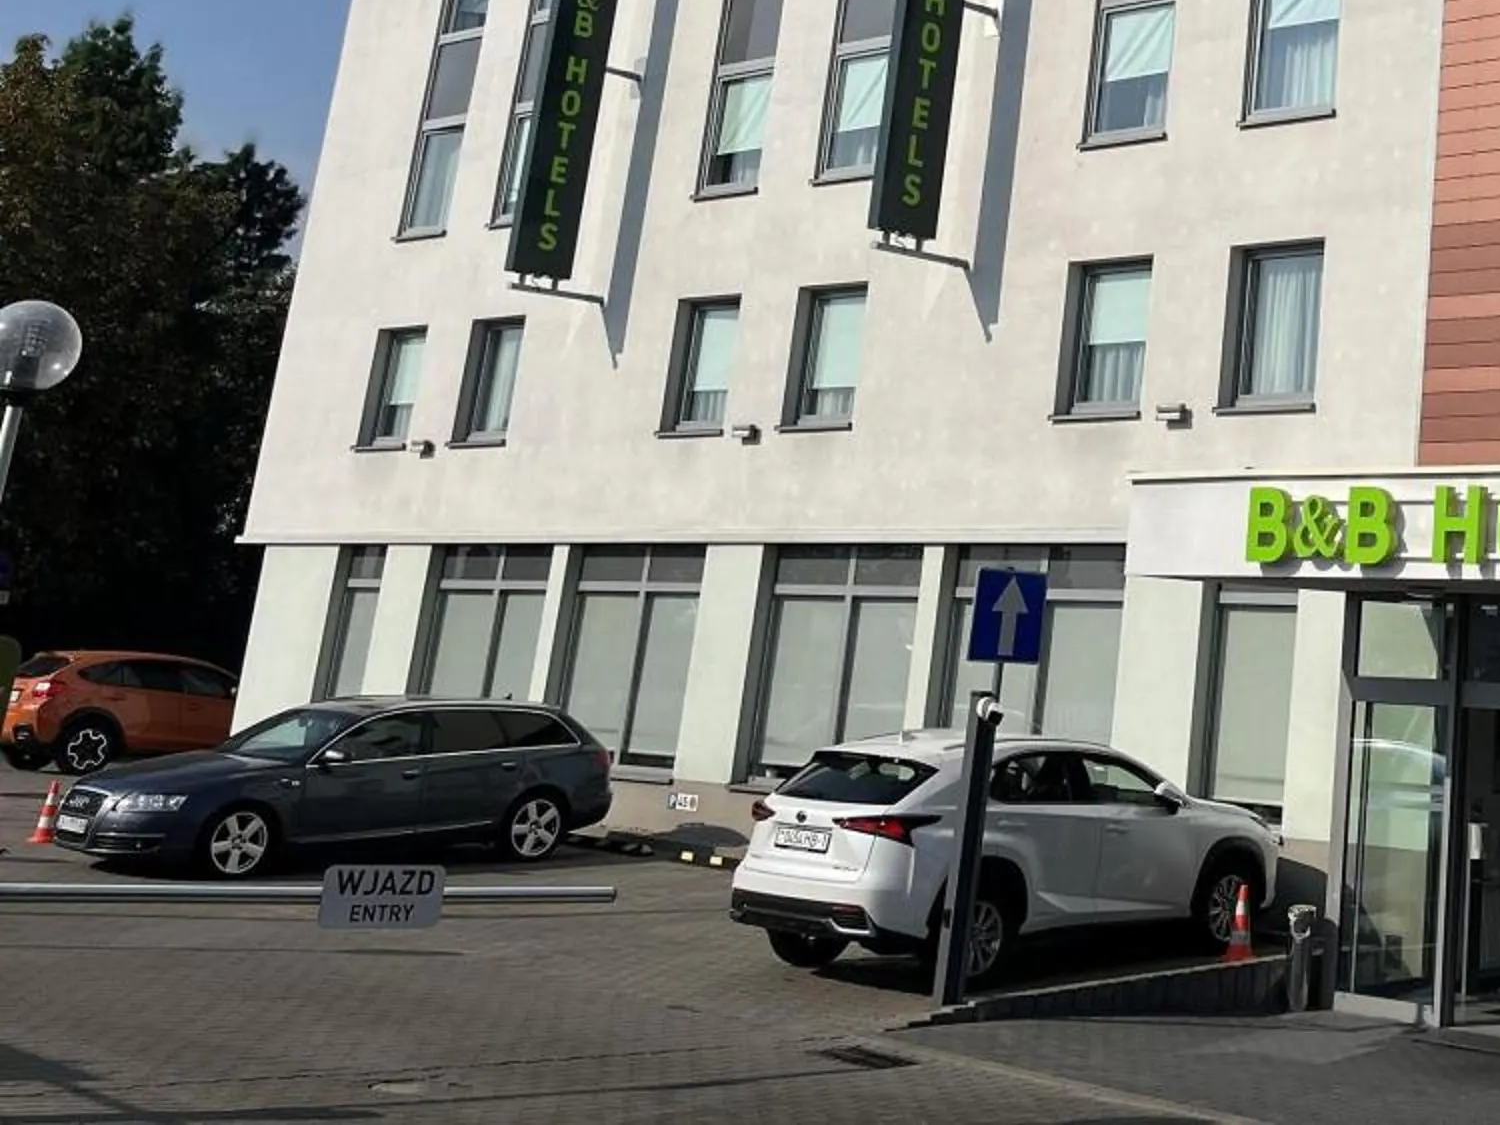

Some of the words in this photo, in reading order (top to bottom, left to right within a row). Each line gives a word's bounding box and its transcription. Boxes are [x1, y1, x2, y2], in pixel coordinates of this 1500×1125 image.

[538, 56, 588, 251] HOTELS
[1245, 486, 1397, 565] B&B
[337, 869, 436, 895] WJAZD
[349, 904, 414, 923] ENTRY
